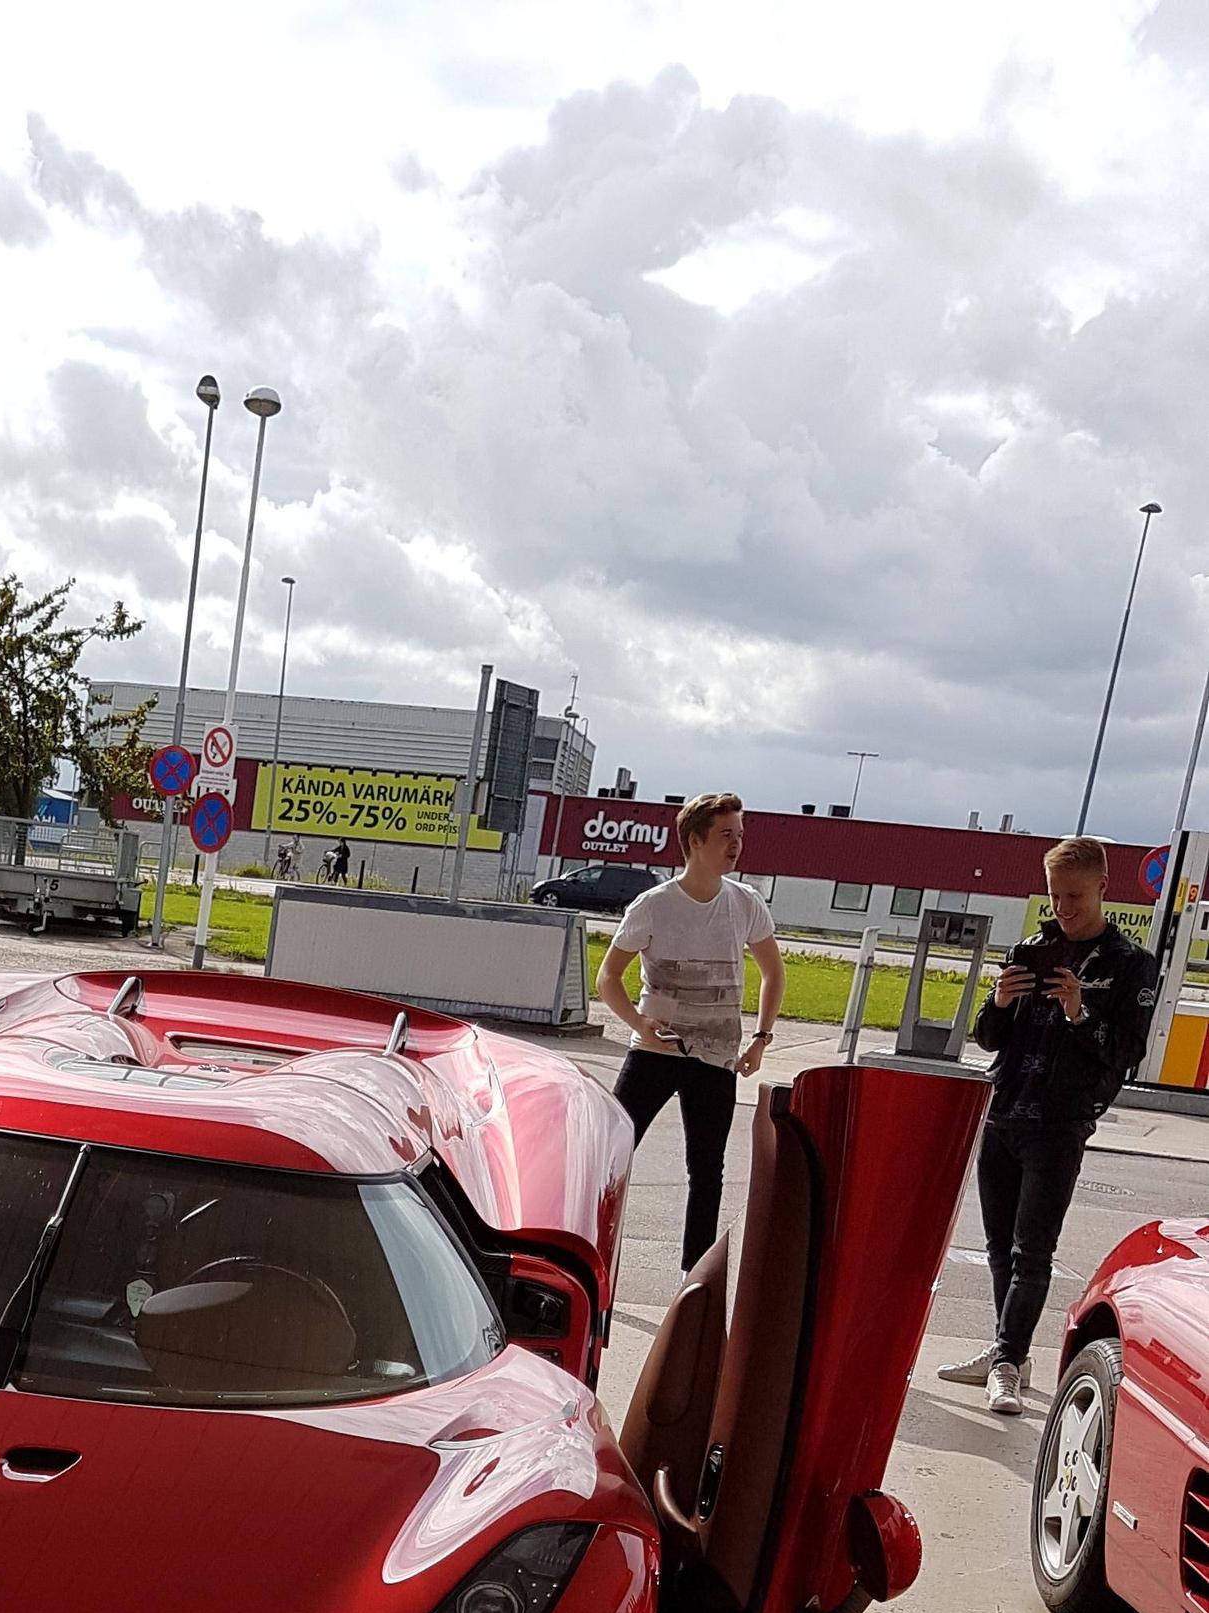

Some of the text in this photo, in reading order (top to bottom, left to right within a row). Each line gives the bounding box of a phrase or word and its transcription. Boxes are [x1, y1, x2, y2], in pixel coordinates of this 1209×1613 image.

[281, 775, 456, 807] KÄNDA VARUMÄRK
[278, 798, 407, 832] 25%-75%
[415, 822, 436, 832] ORD
[583, 810, 669, 854] dormy
[581, 841, 630, 853] OUTLET
[50, 879, 60, 891] 5
